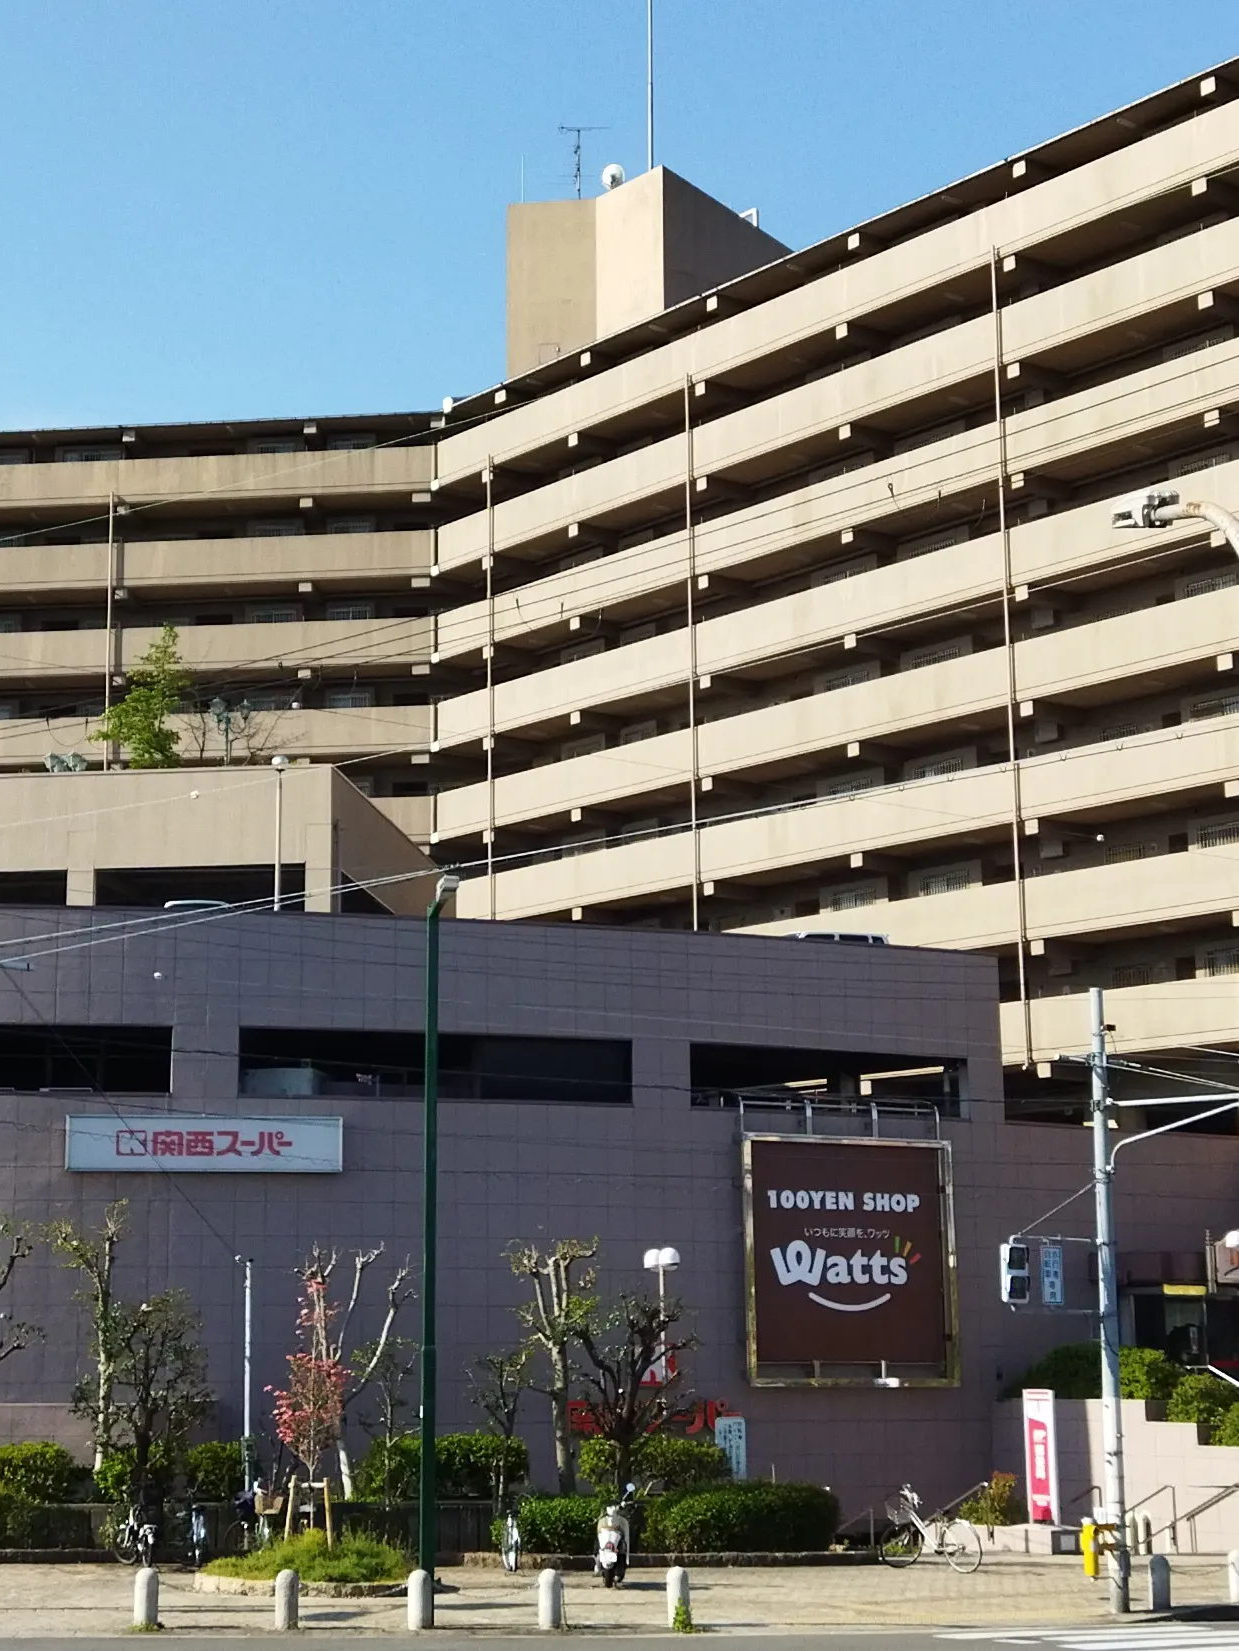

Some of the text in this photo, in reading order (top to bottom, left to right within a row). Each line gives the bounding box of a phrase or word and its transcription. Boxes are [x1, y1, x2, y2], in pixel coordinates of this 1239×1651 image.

[152, 1131, 293, 1156] 関西スーパー
[767, 1190, 920, 1213] 100YEN SHOP
[770, 1239, 908, 1287] Watts
